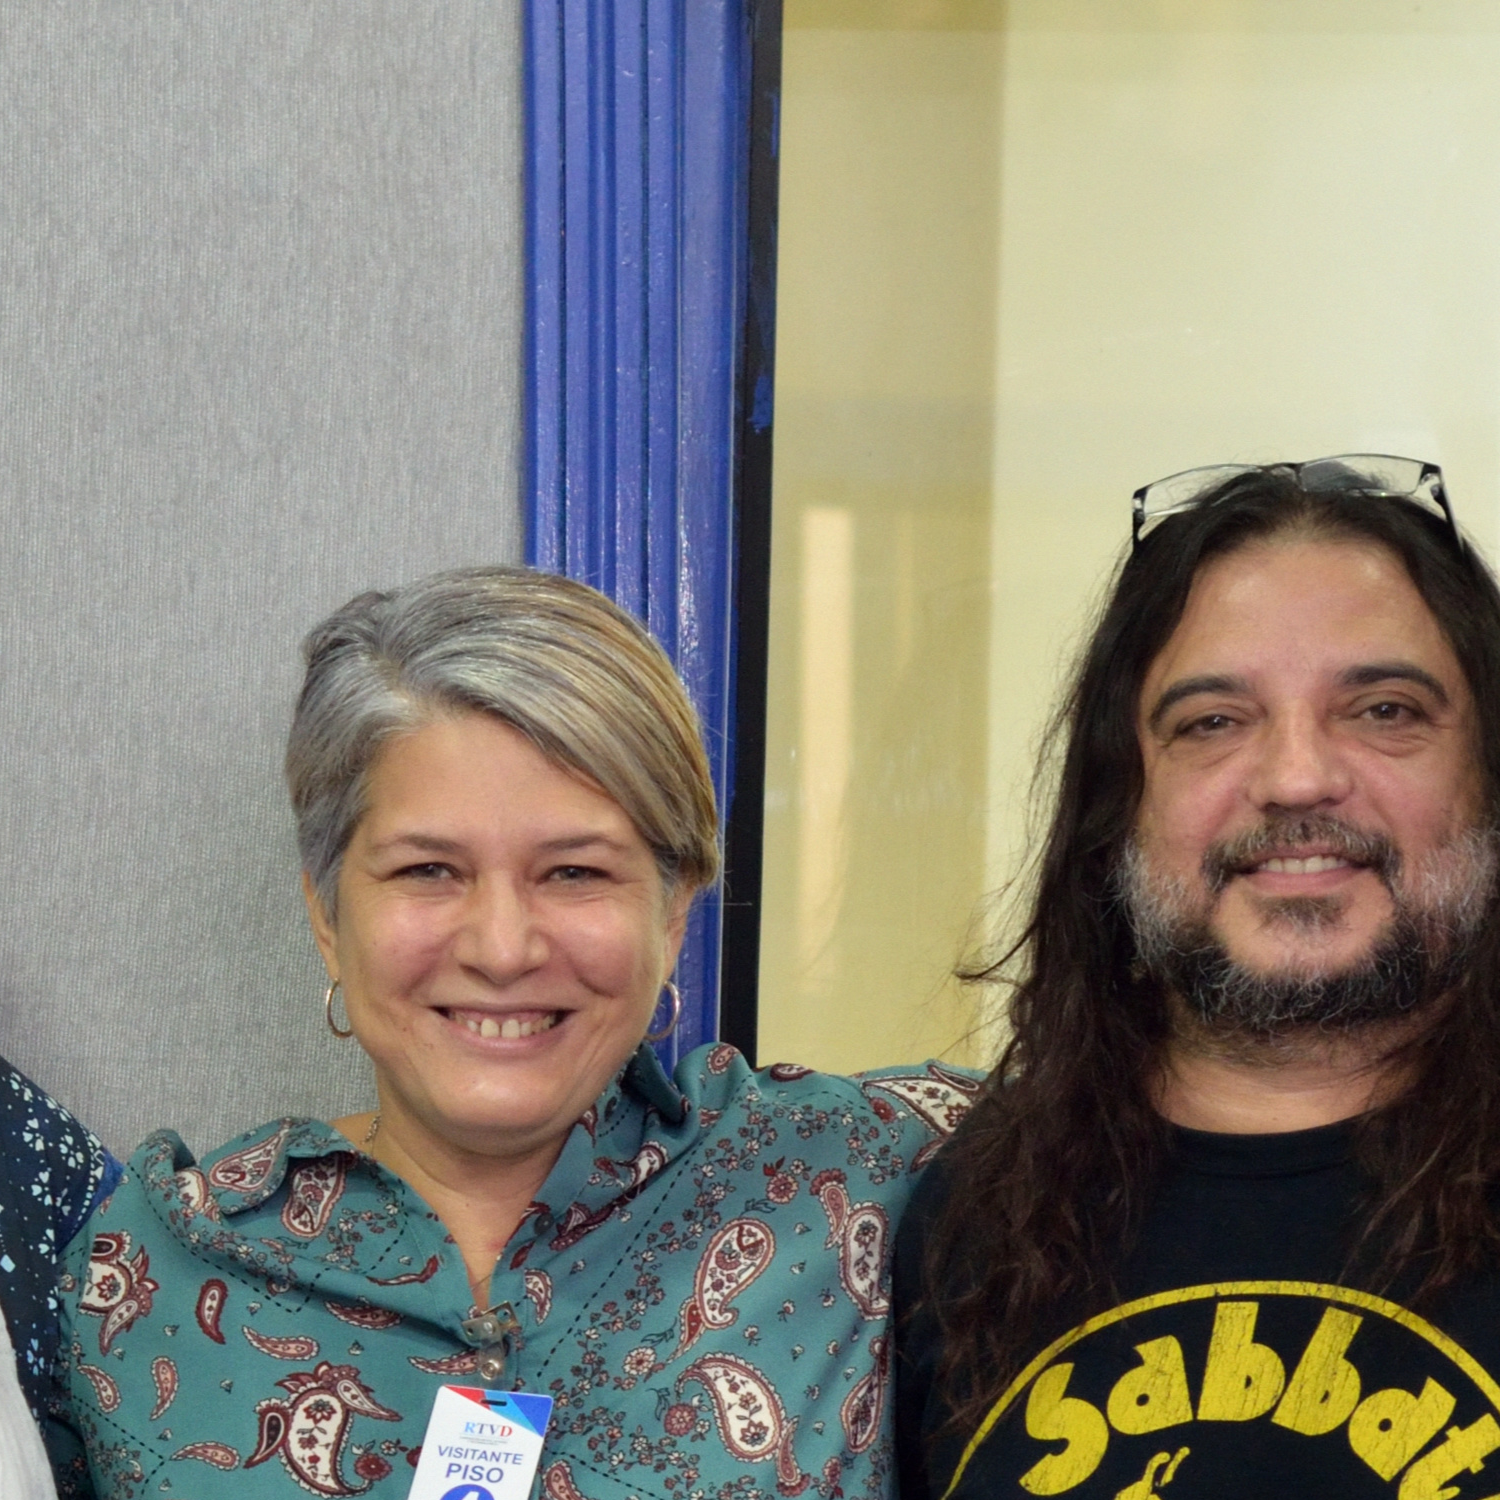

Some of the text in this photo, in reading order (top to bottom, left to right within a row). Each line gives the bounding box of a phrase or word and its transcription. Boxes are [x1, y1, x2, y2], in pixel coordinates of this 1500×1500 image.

[464, 1421, 513, 1438] RTVD
[437, 1445, 524, 1466] VISITANTE
[445, 1462, 504, 1484] PISO
